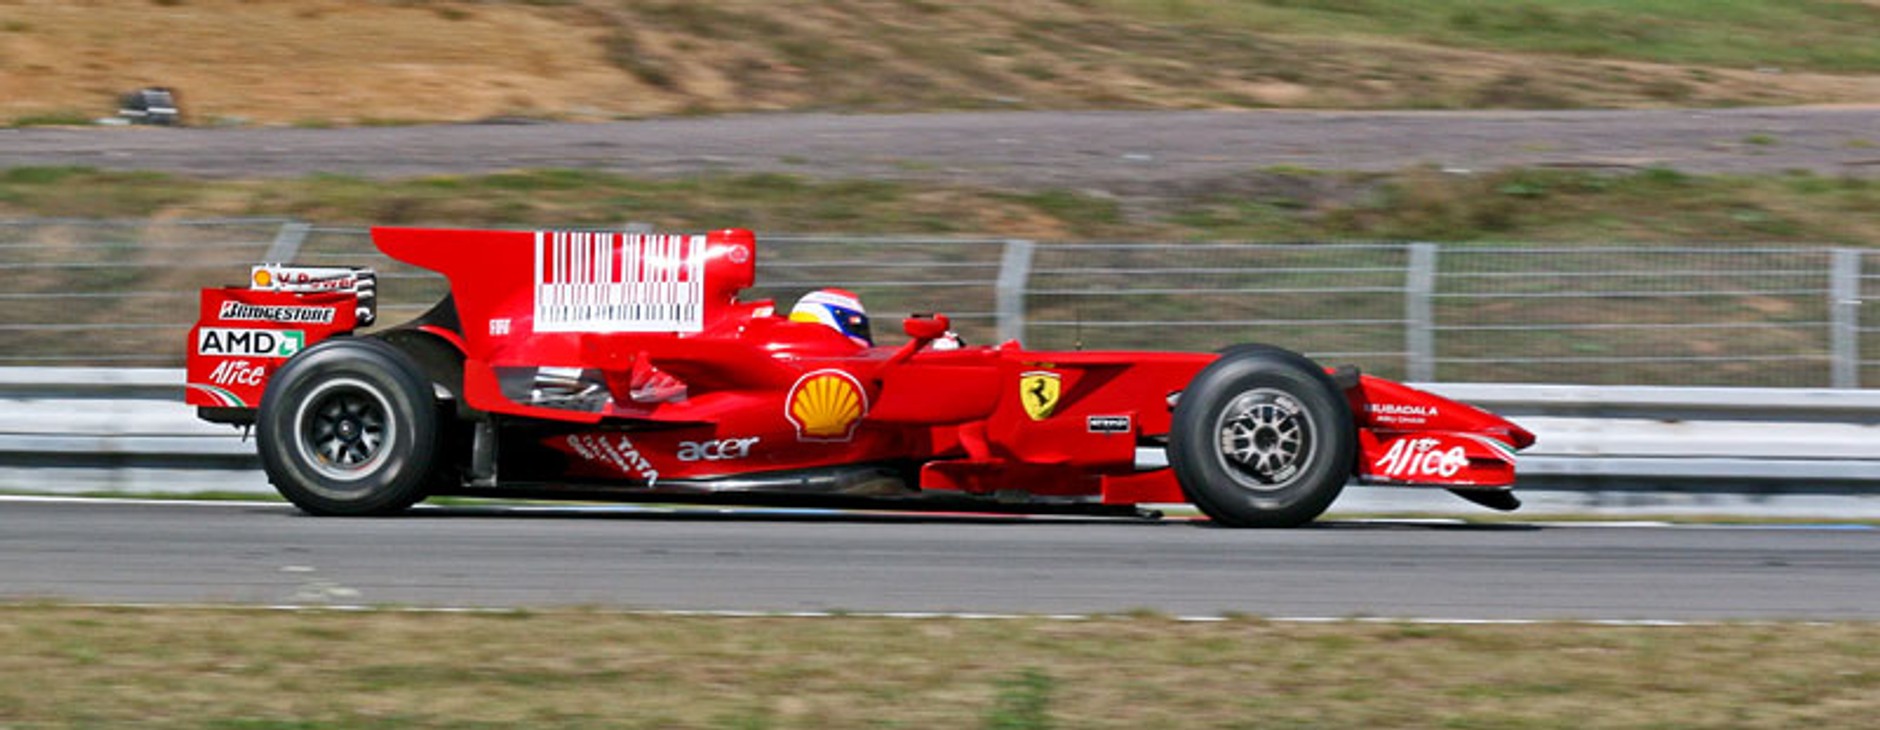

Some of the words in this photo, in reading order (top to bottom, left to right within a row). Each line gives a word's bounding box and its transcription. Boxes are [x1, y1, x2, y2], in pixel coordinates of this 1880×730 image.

[221, 302, 332, 321] BRIDGESTONE
[201, 330, 276, 354] AMD
[209, 358, 265, 386] Alice
[618, 435, 659, 488] TATA
[676, 435, 759, 462] acer
[1376, 437, 1470, 477] Alice
